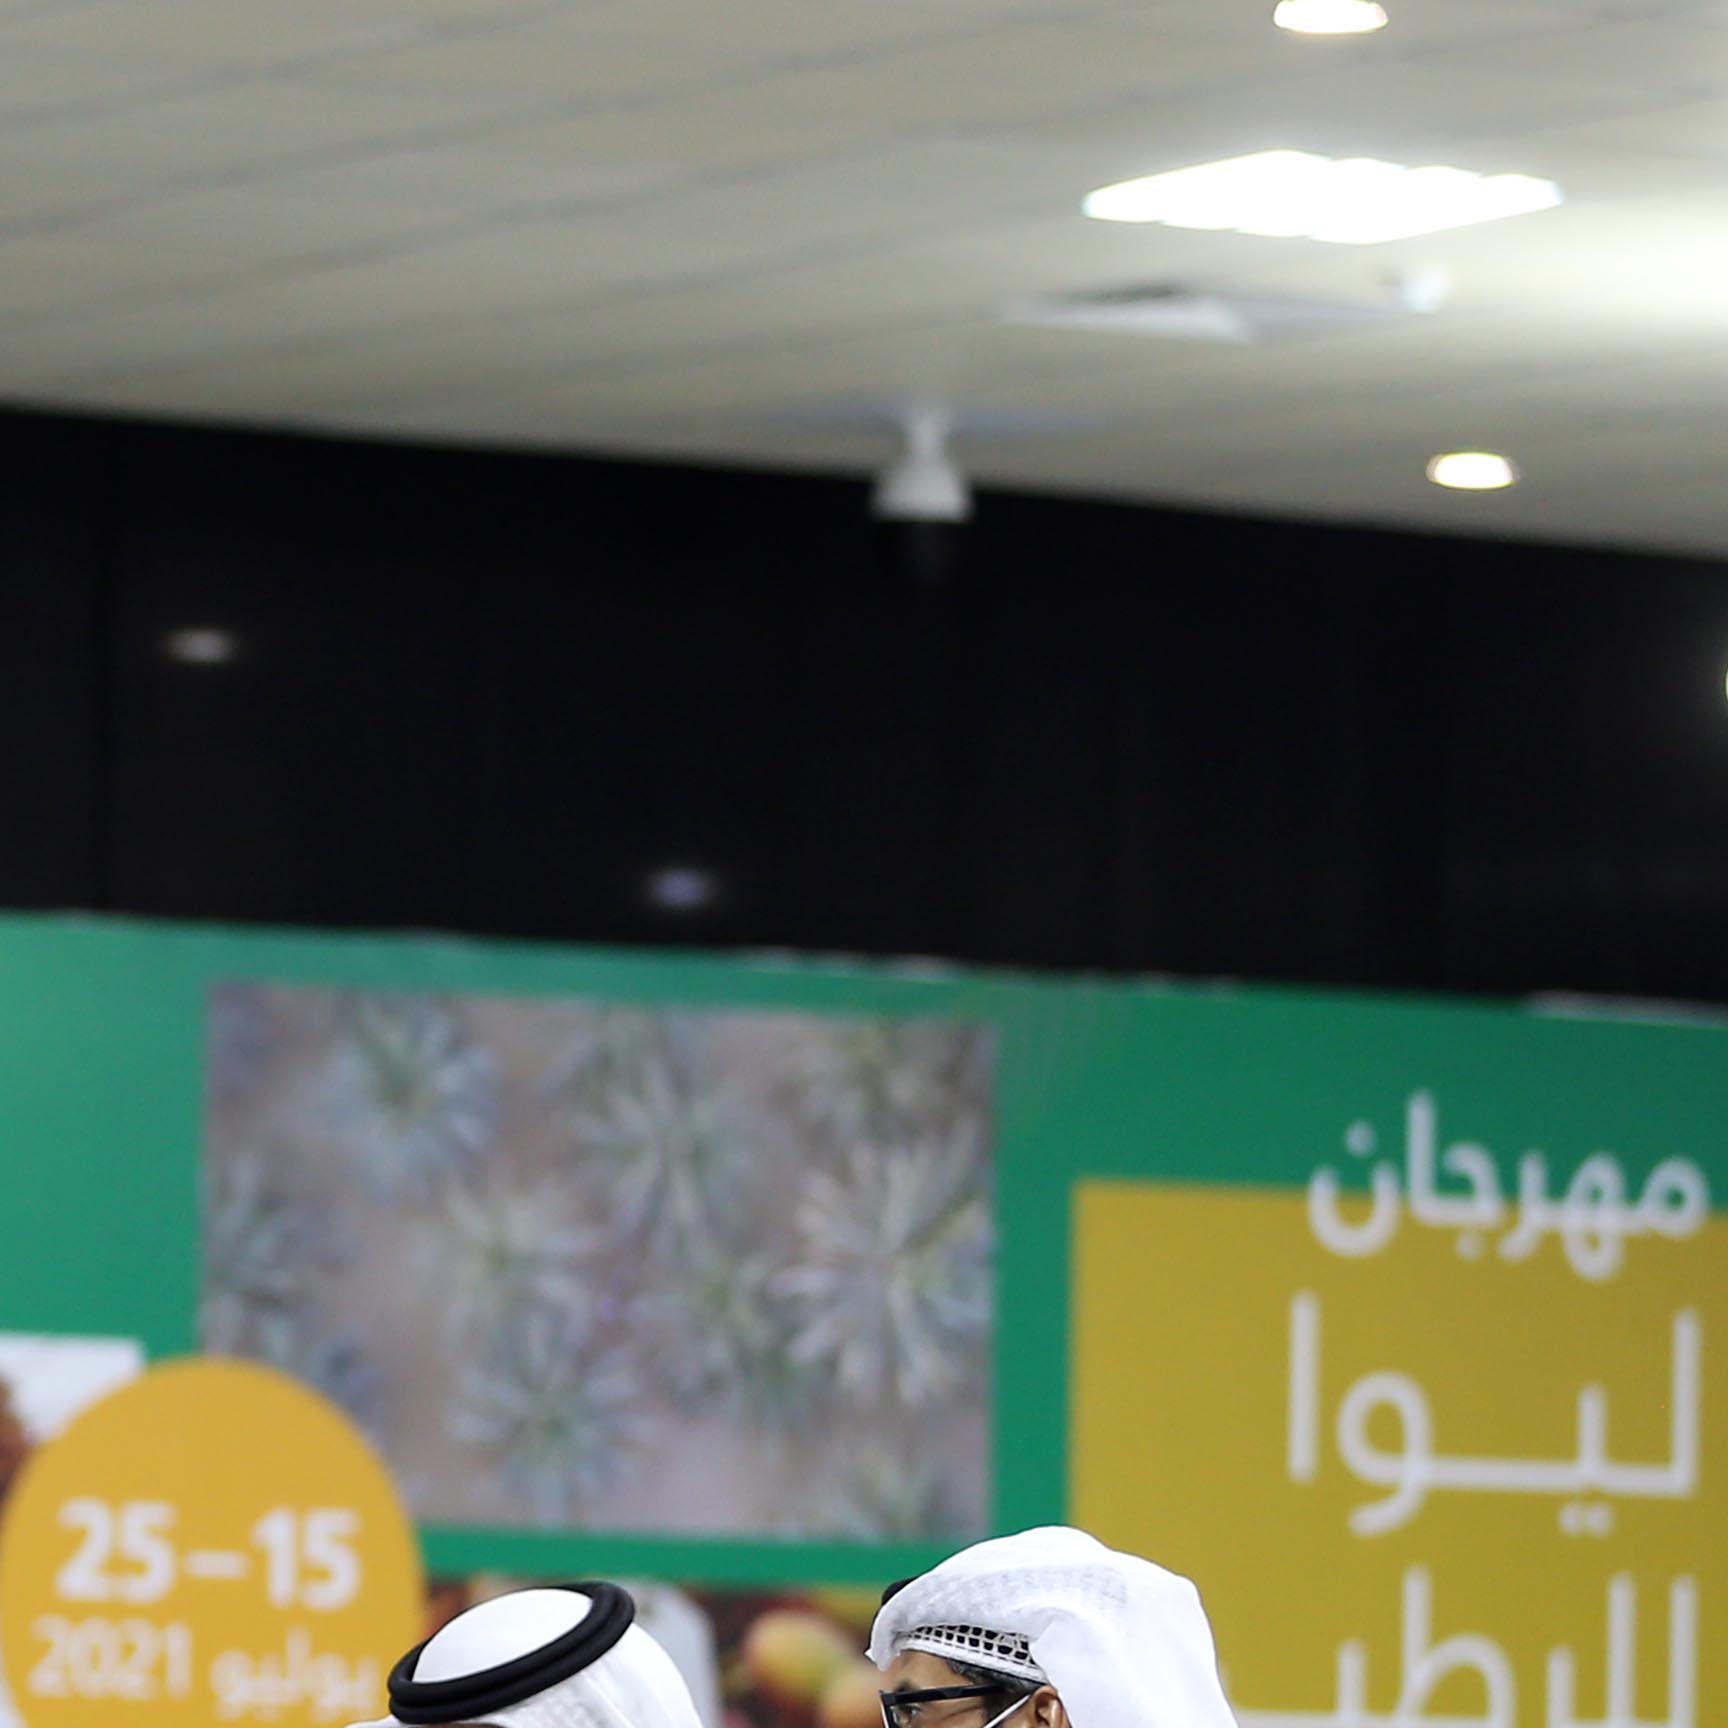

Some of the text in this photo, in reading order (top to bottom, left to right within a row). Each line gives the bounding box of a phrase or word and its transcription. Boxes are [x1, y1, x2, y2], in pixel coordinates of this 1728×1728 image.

[1307, 1092, 1708, 1281] مهرجان
[1288, 1291, 1702, 1536] ليوا
[28, 1615, 382, 1720] يوليو 2021
